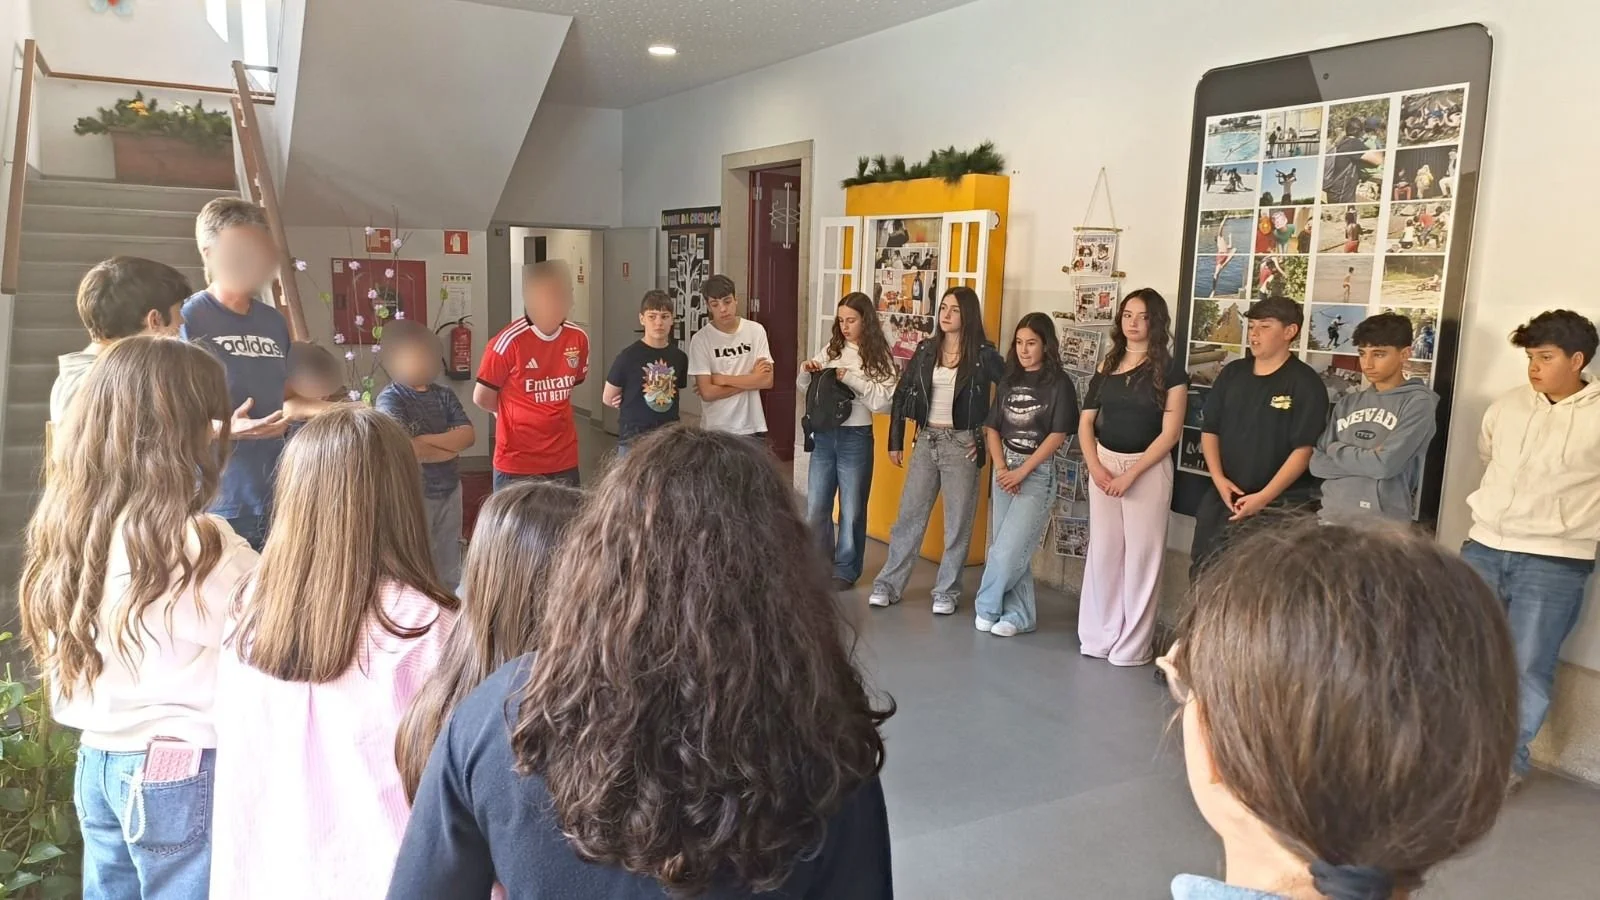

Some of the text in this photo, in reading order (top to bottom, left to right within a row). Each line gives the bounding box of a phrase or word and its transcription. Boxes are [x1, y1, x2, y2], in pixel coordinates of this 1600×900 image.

[220, 335, 281, 355] adidas
[714, 342, 751, 358] Levi's
[525, 374, 576, 393] Emirate
[534, 389, 572, 403] FLY BETT
